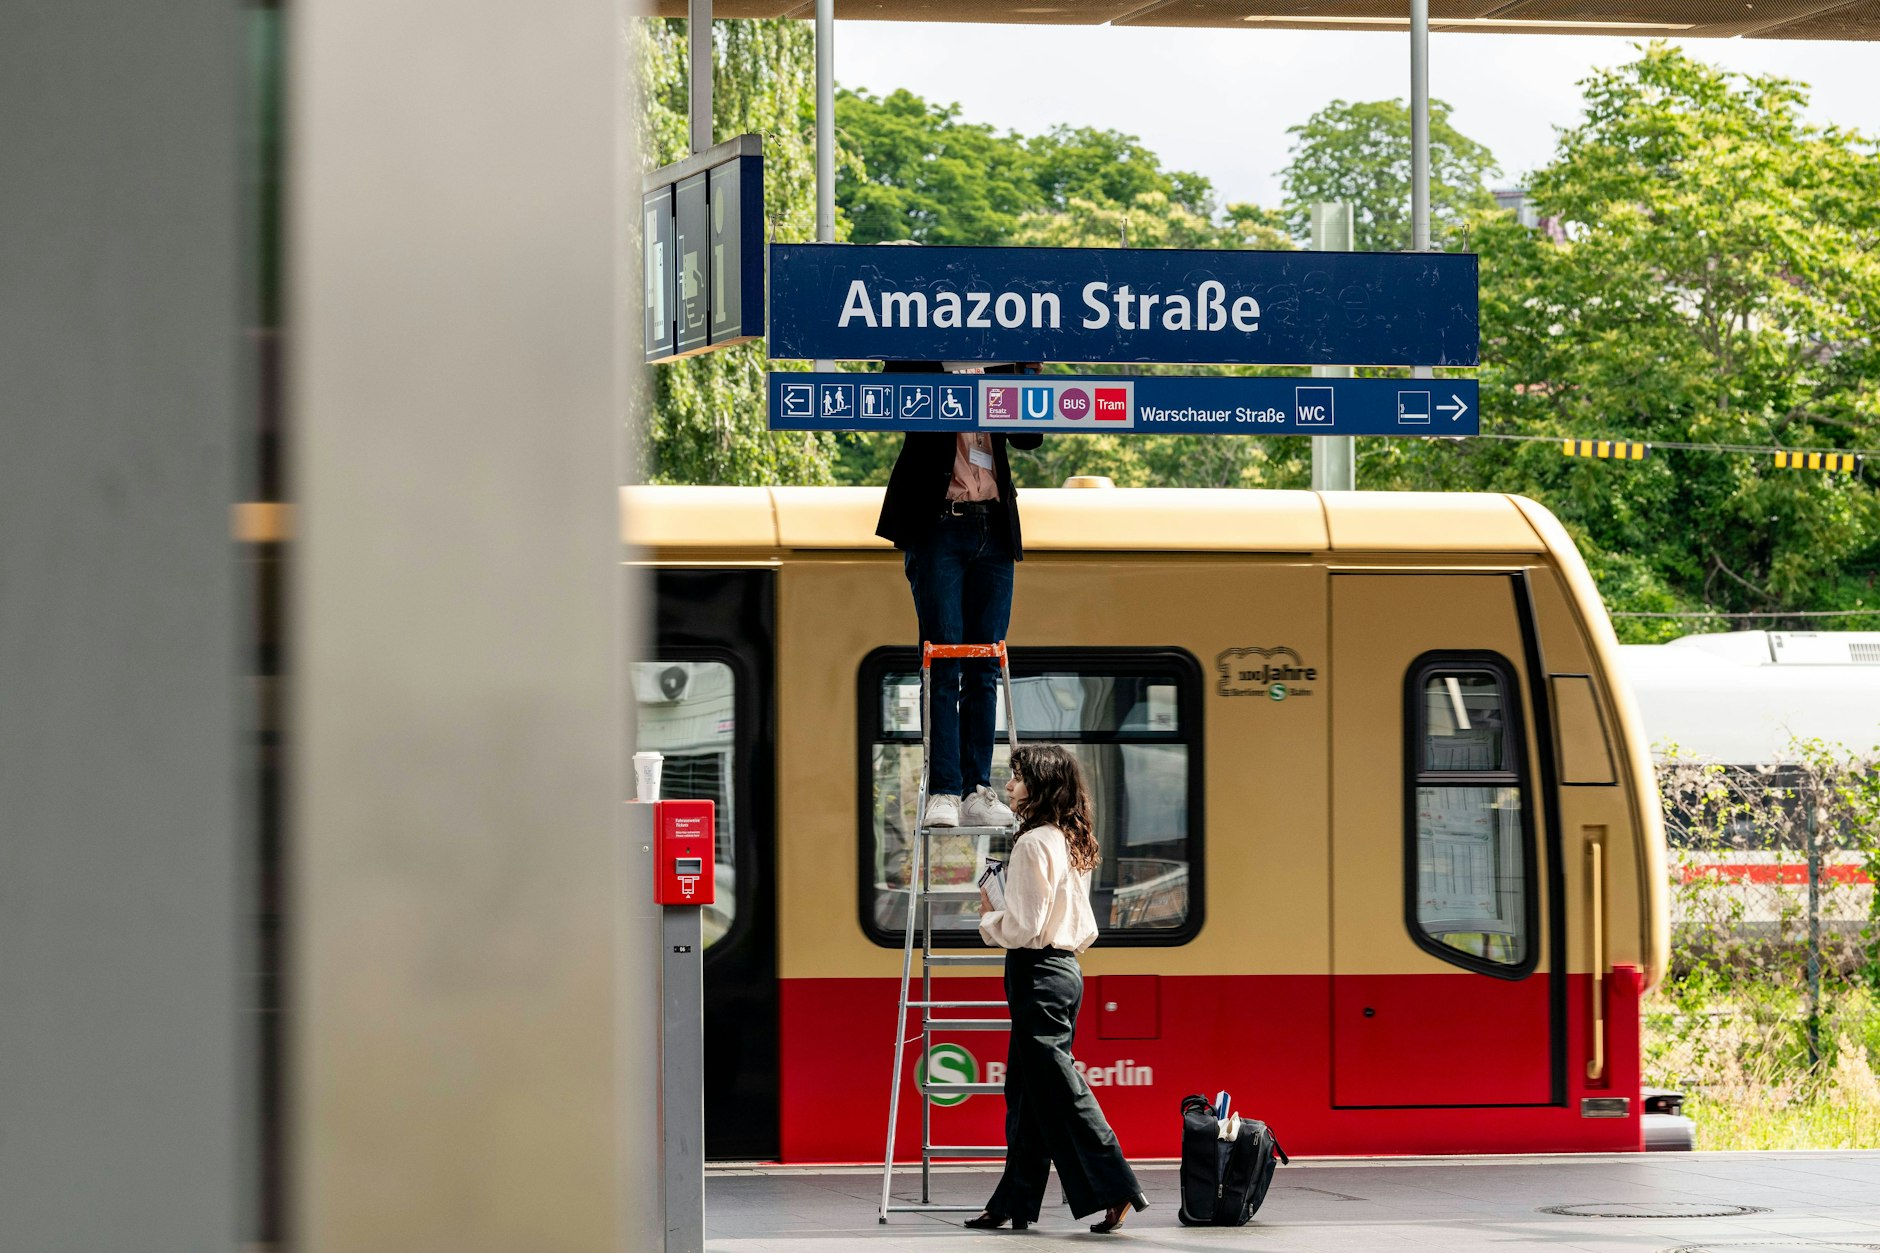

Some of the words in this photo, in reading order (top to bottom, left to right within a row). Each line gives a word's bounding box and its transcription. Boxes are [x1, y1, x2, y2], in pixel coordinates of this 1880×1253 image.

[837, 280, 1061, 329] Amazon
[1082, 280, 1261, 333] Straße
[1027, 389, 1049, 419] U
[1063, 398, 1086, 410] BUS
[1097, 398, 1125, 411] Tram
[1298, 405, 1326, 421] WC
[1140, 406, 1232, 423] Warschauer
[1235, 407, 1286, 424] Straße
[1262, 664, 1318, 684] Jahre
